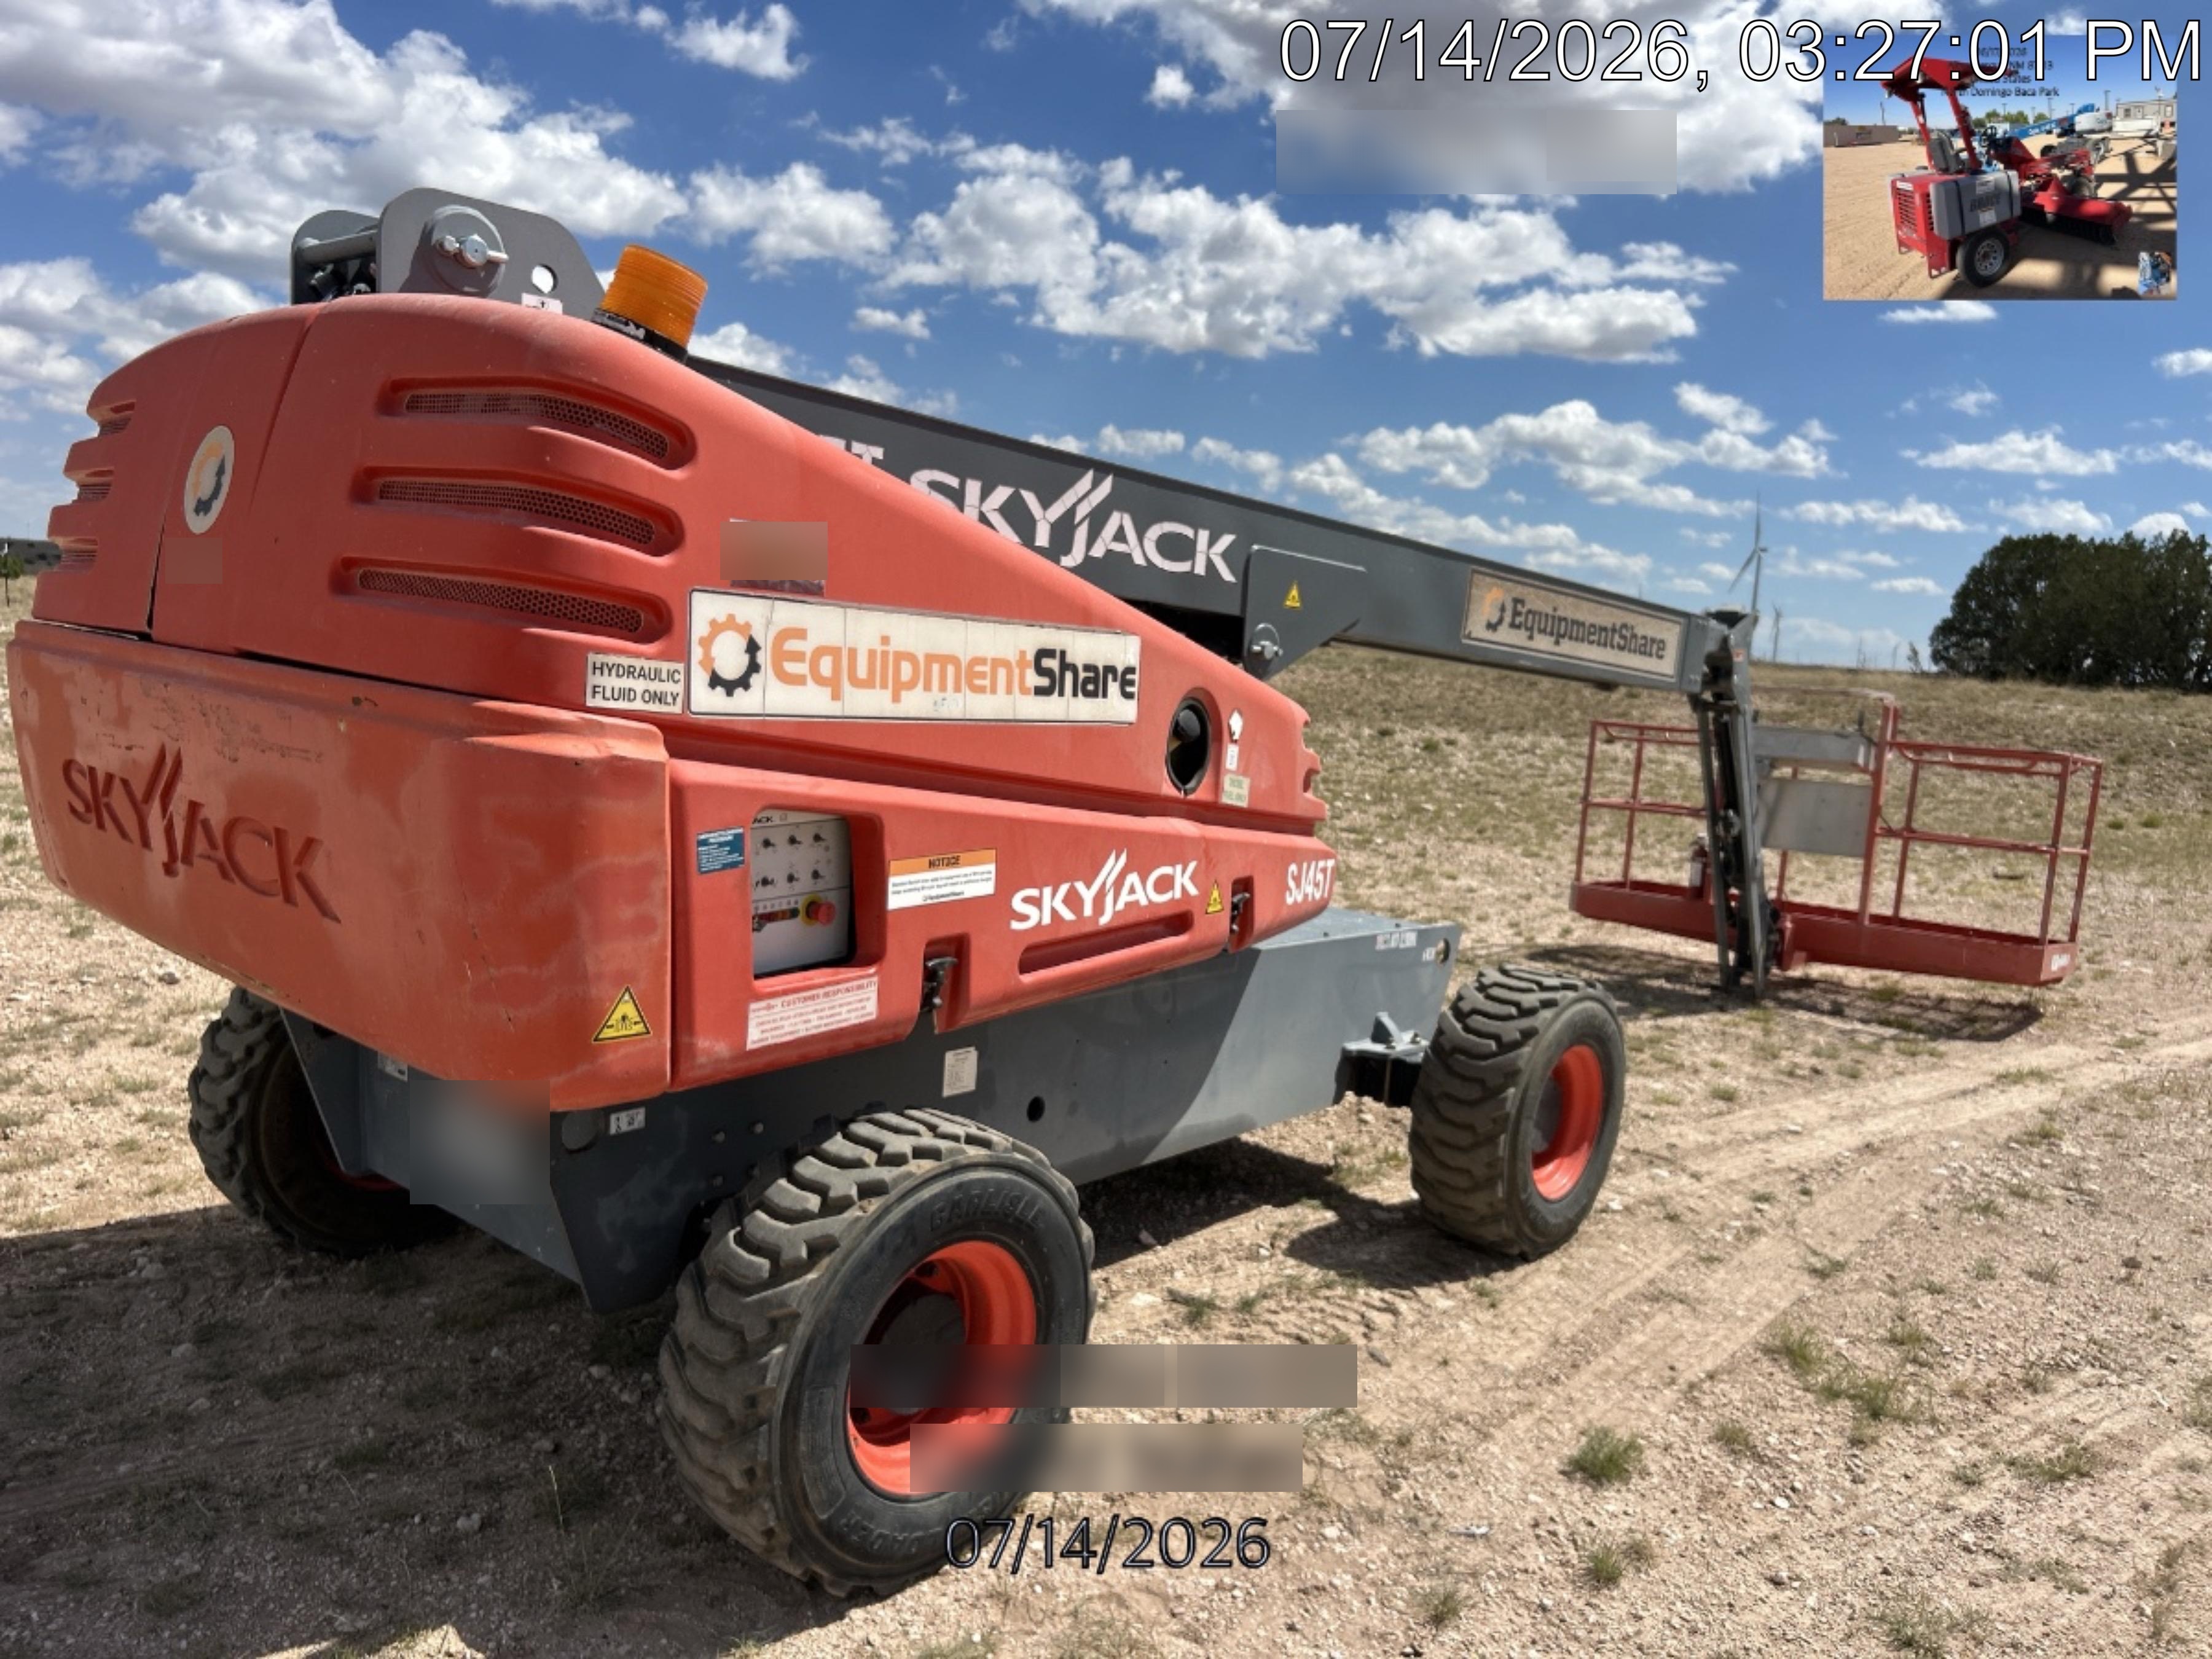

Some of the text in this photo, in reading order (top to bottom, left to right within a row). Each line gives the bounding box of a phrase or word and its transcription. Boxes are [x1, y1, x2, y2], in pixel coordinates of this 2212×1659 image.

[909, 468, 1237, 584] SKYJACK
[1509, 598, 1665, 659] EquipmentShare
[592, 661, 681, 684] HYDRAULIC
[770, 627, 1137, 703] EquipmentShare
[591, 685, 680, 707] FLUID ONLY
[61, 742, 342, 924] SKYJACK
[928, 855, 960, 869] NOTICE
[1285, 858, 1335, 906] SJ45T
[1010, 849, 1199, 930] SKYJACK
[781, 992, 821, 1008] CUSTOMER
